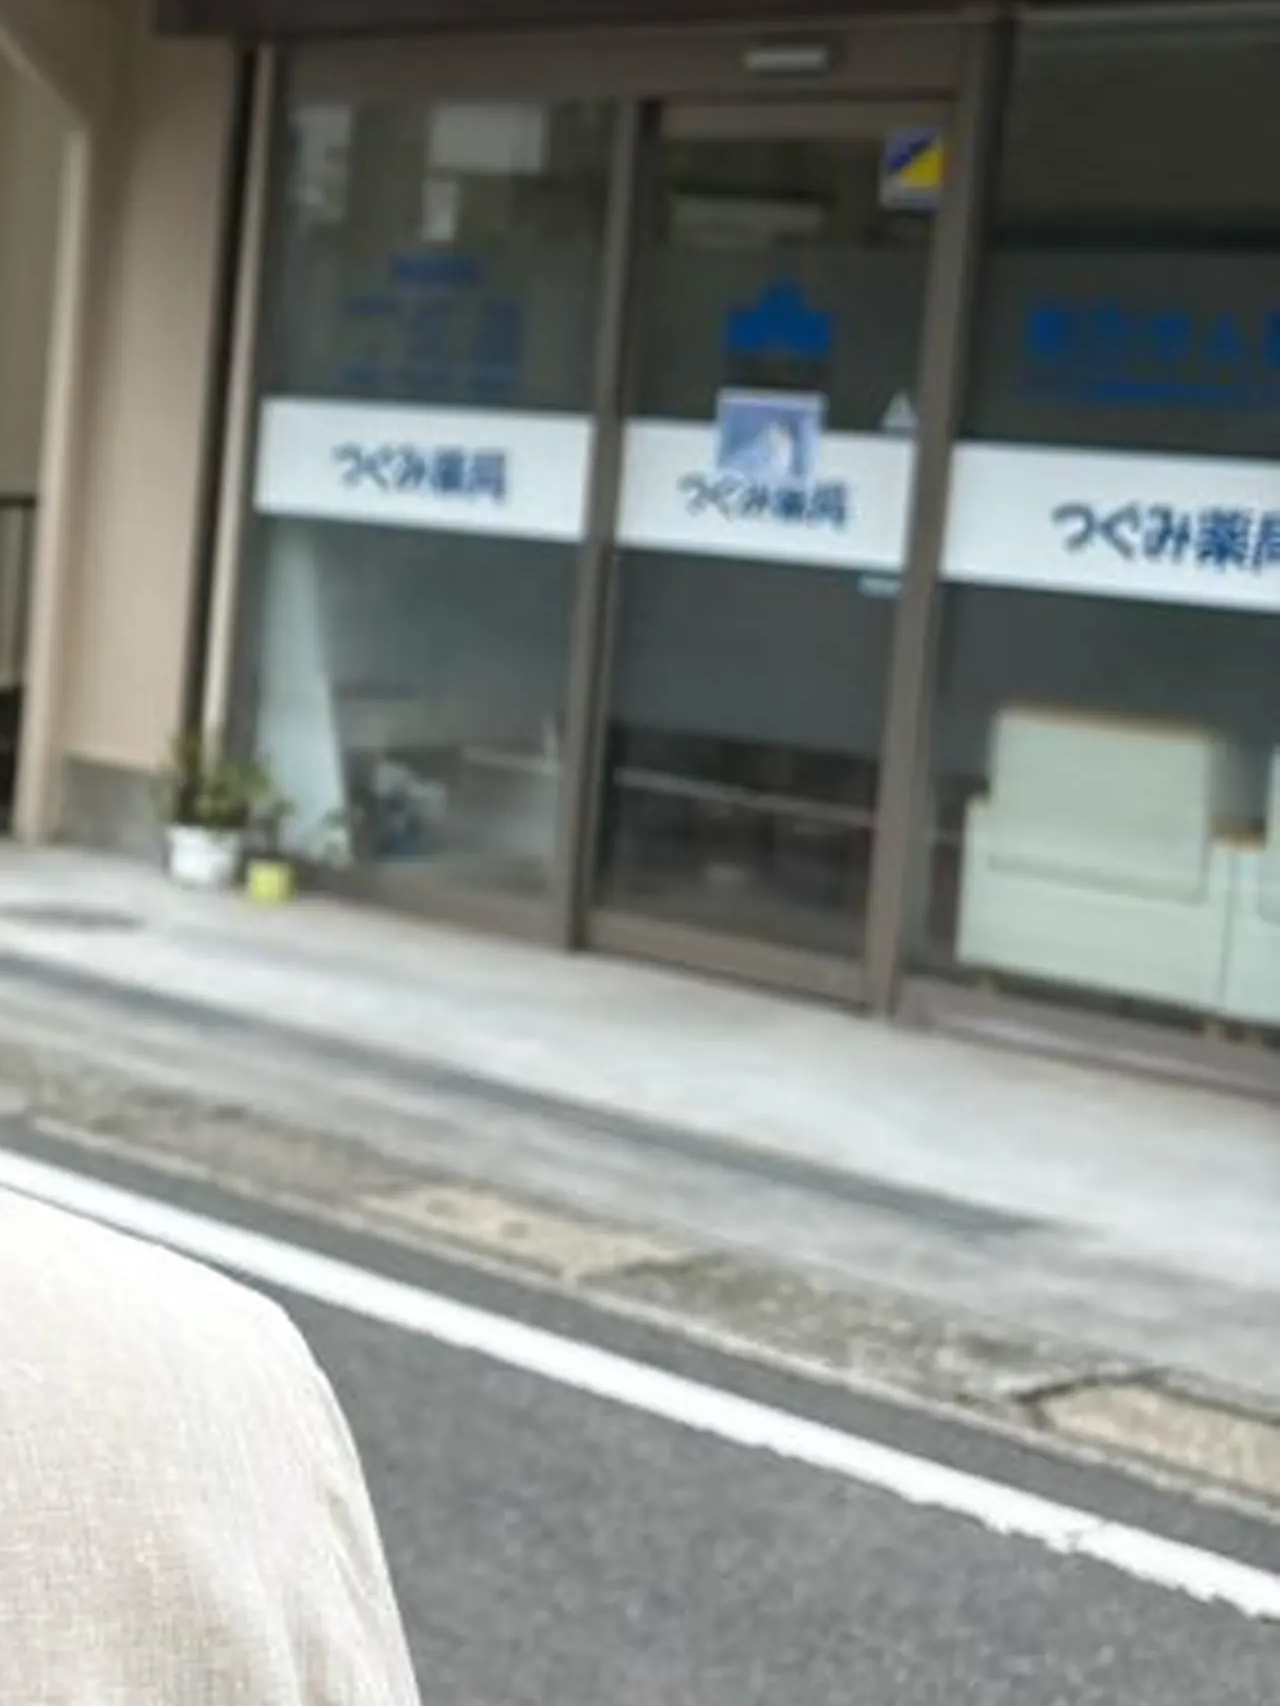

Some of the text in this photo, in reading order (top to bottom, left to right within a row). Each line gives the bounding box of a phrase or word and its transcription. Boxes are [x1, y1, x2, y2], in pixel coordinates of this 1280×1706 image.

[334, 441, 506, 506] つぐみ薬局
